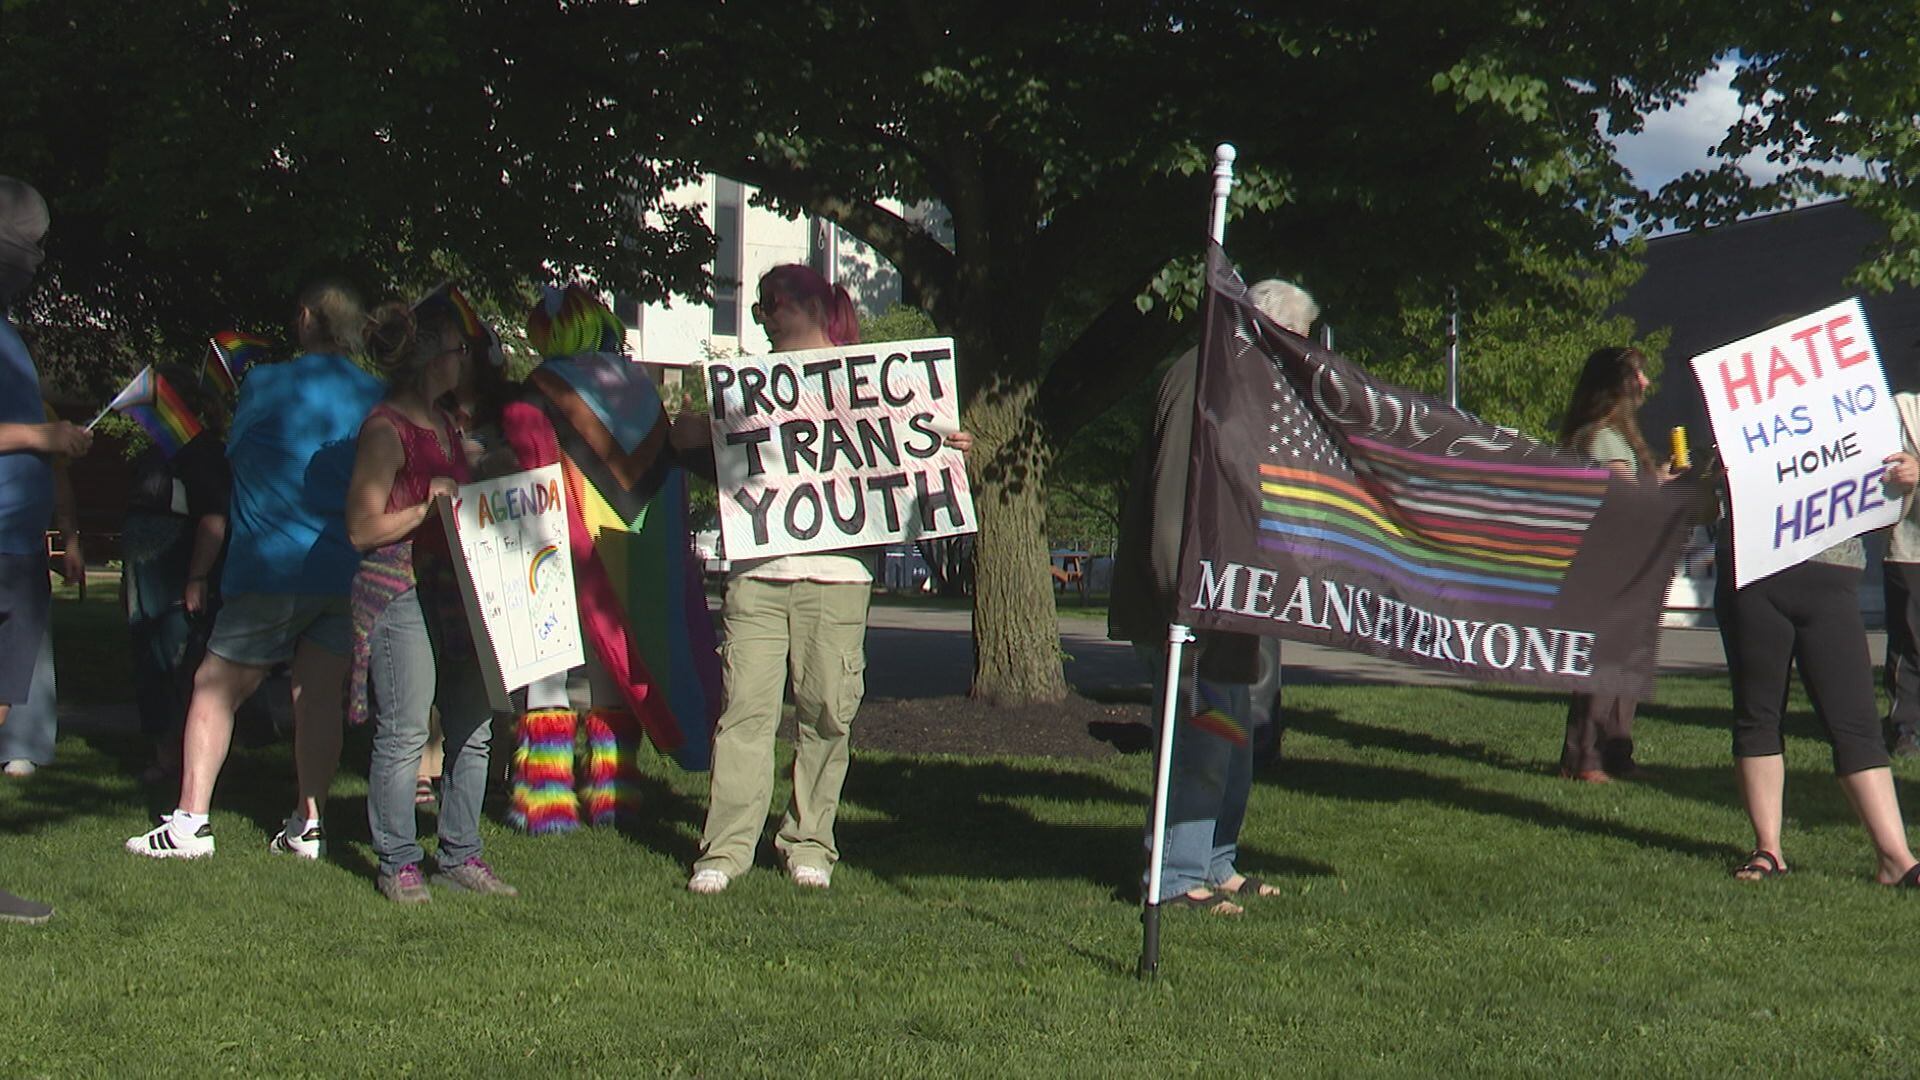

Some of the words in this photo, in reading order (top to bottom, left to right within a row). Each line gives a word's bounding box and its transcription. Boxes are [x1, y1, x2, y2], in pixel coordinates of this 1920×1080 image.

[708, 348, 952, 419] PROTECT
[1718, 314, 1870, 411] HATE
[726, 412, 942, 477] TRANS
[1742, 405, 1814, 453] HAS
[1832, 384, 1877, 422] NO
[1776, 432, 1862, 483] HOME
[479, 479, 561, 528] AGENDA
[733, 467, 965, 545] YOUTH
[1773, 466, 1888, 549] HERE
